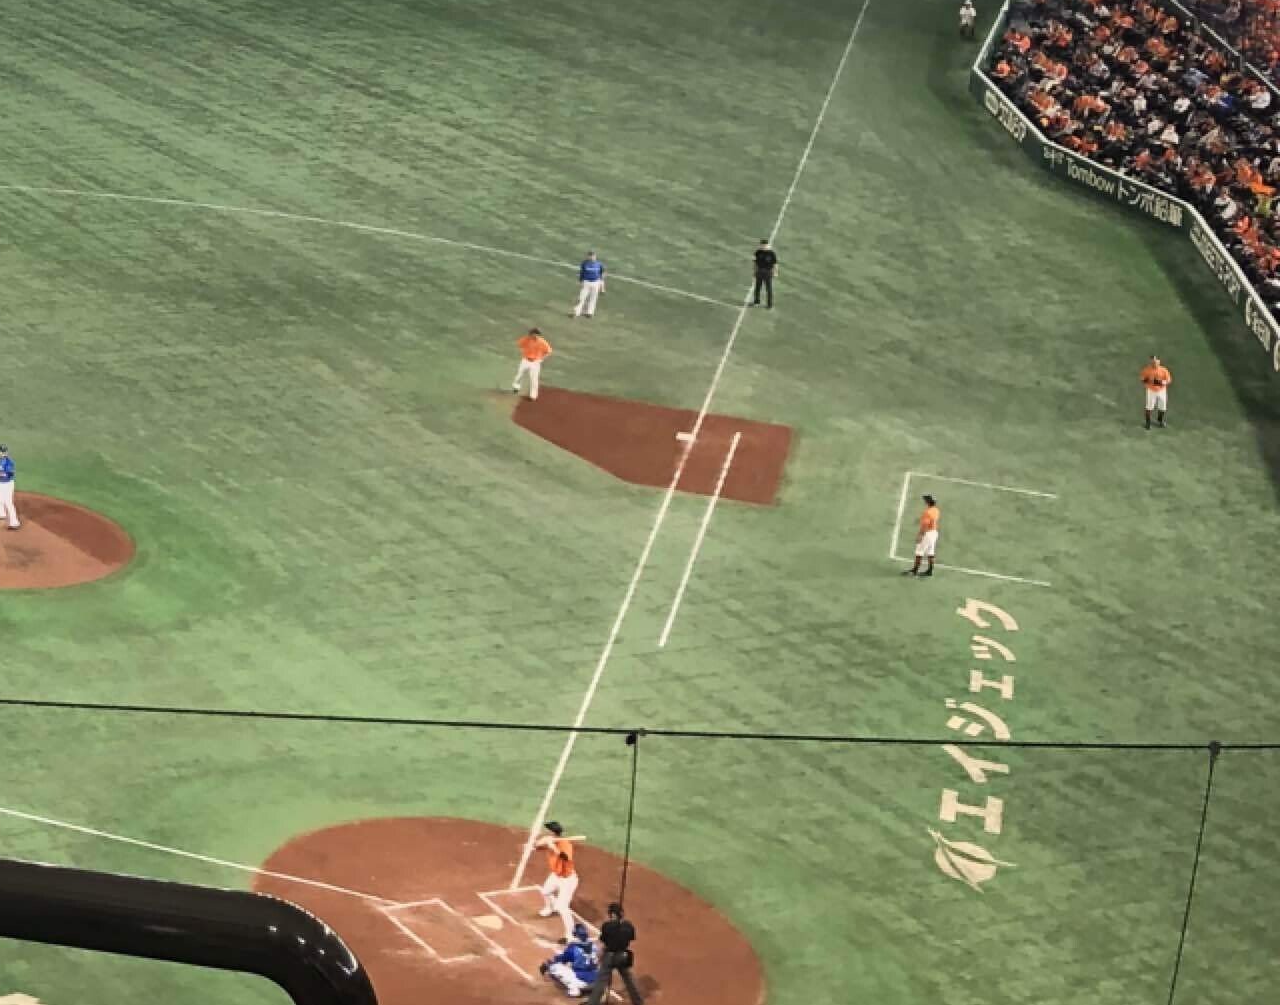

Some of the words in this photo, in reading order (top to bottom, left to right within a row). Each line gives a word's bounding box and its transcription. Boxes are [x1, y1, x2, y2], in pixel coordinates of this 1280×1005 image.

[1066, 157, 1116, 195] Tombow
[939, 597, 1020, 835] エイジェック
